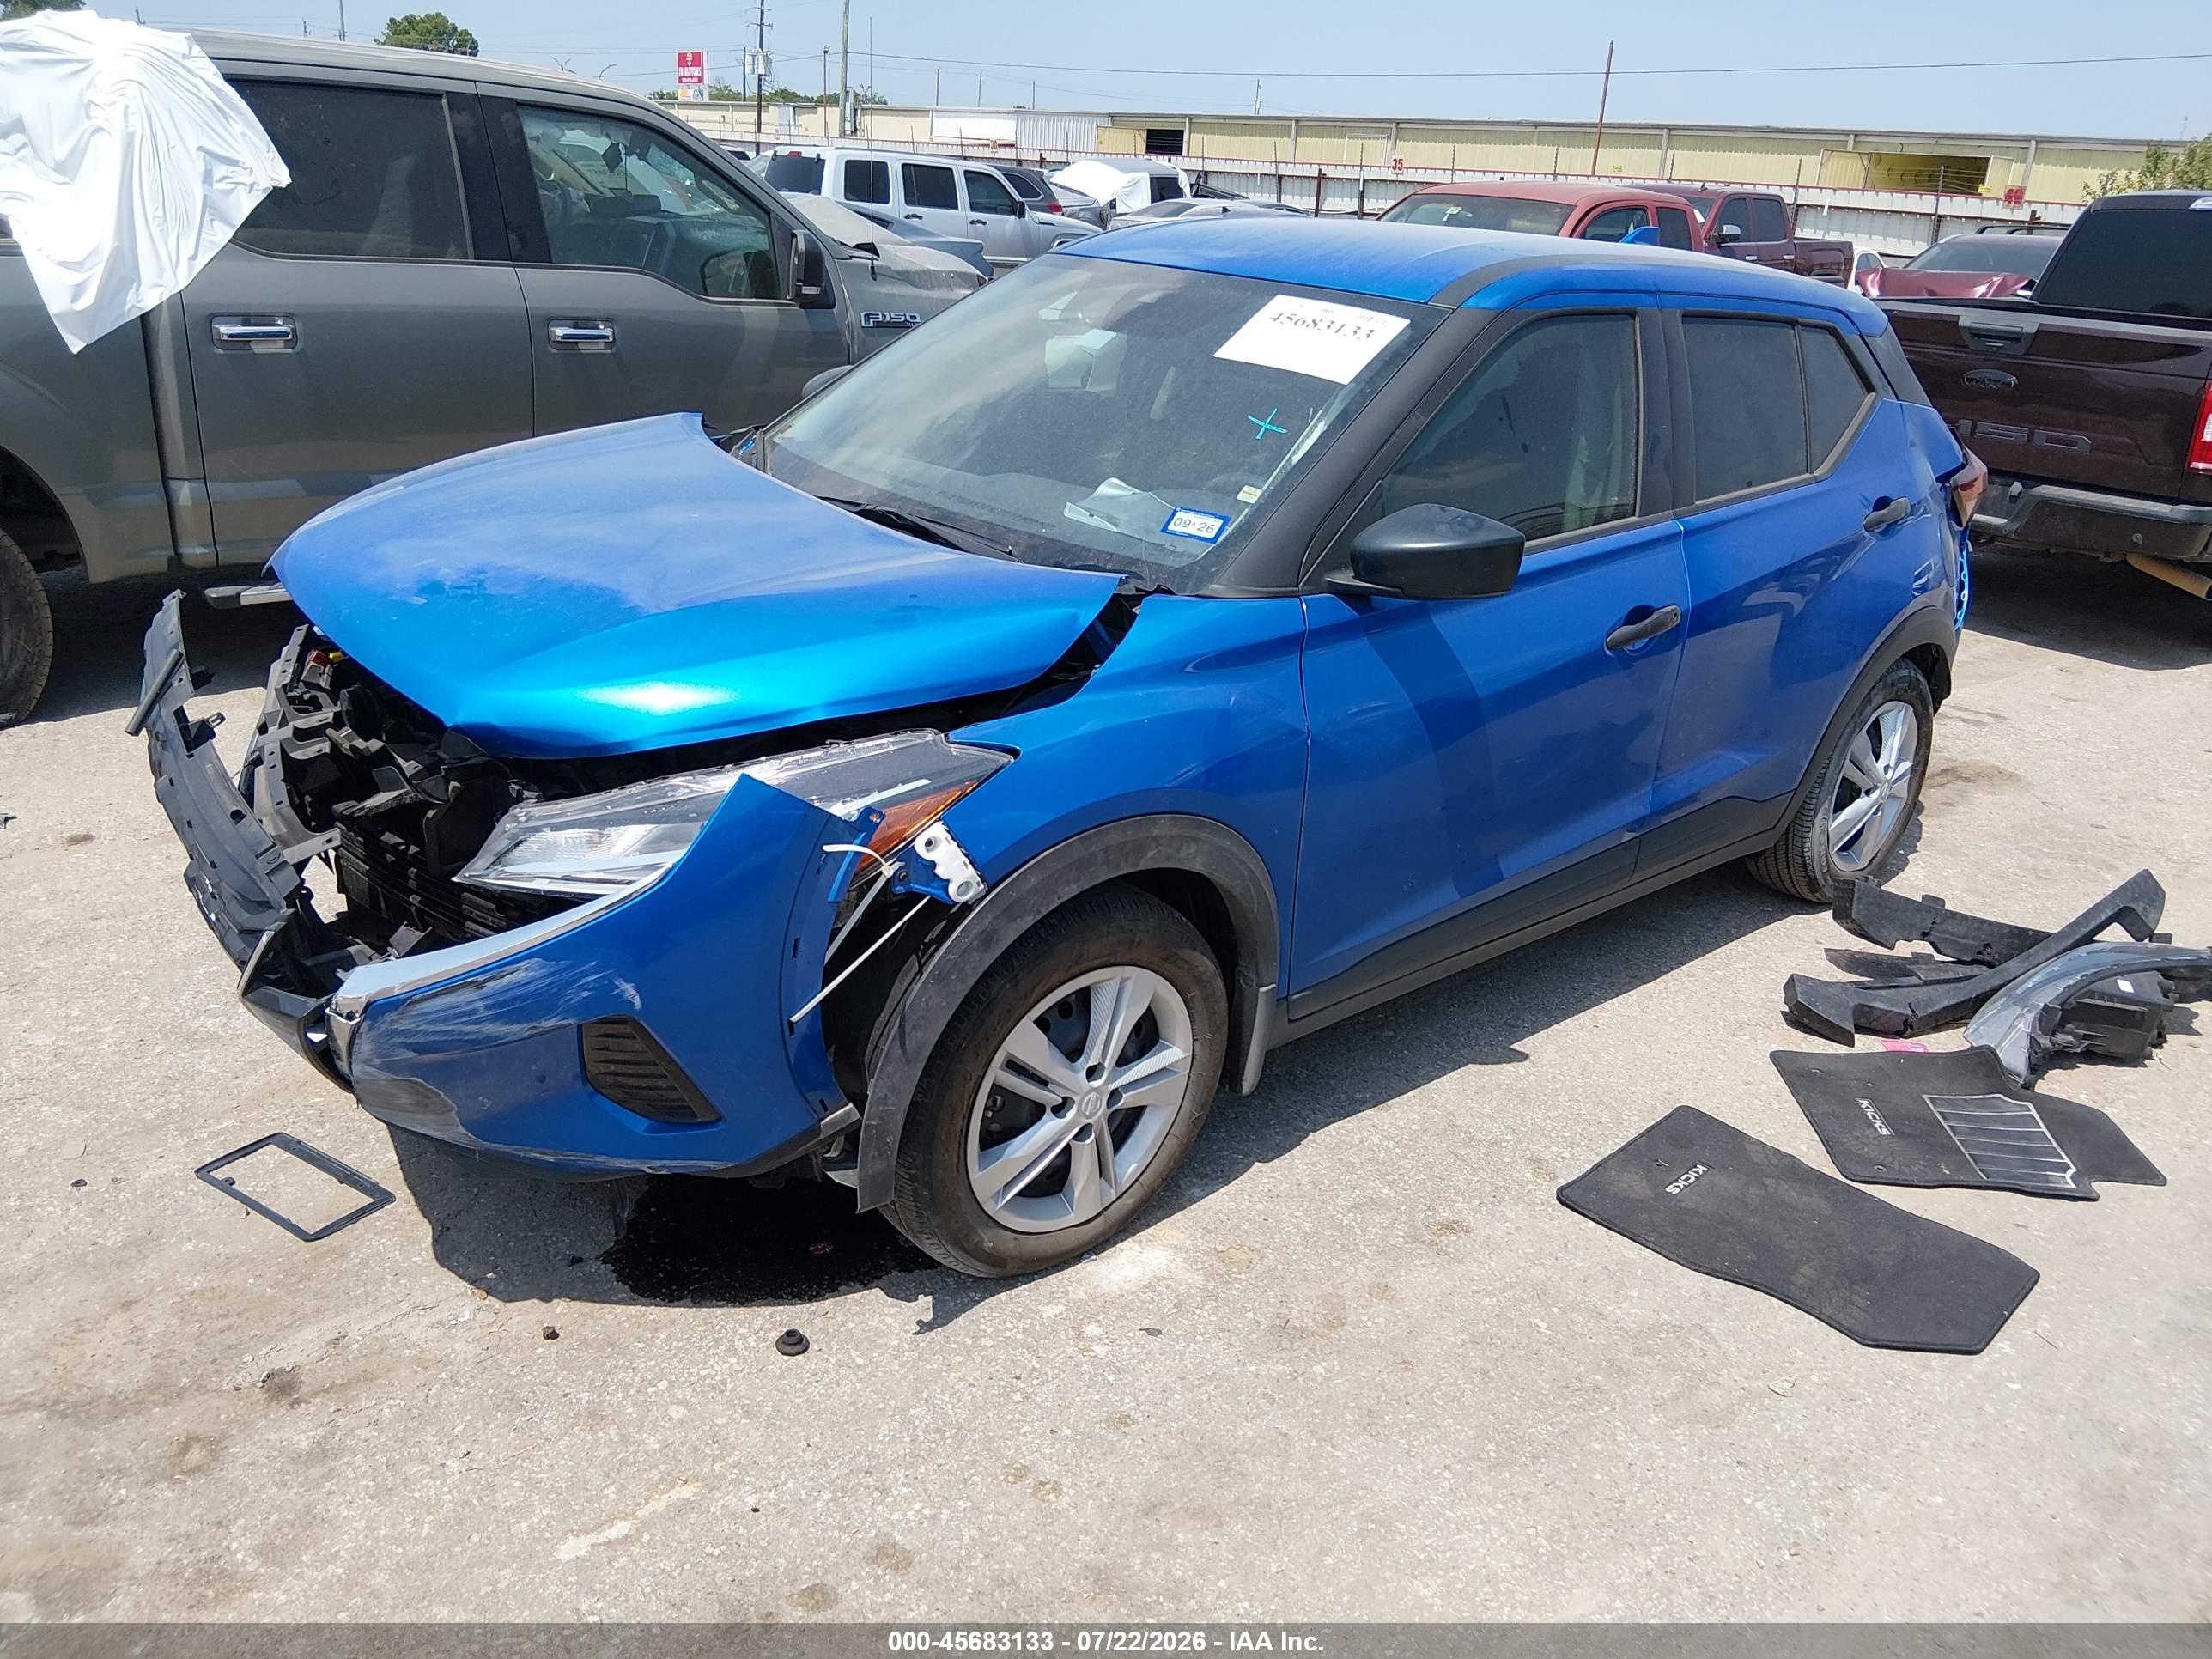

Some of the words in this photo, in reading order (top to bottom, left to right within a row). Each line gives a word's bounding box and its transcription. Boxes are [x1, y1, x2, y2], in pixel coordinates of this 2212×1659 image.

[1392, 158, 1404, 171] 35
[860, 312, 921, 326] F150
[1268, 312, 1375, 340] 45683133
[1948, 419, 2092, 455] 150
[1173, 517, 1192, 528] 09
[1196, 521, 1216, 534] 26
[1858, 1099, 1891, 1135] KICKS
[1665, 1164, 1708, 1195] KICKS
